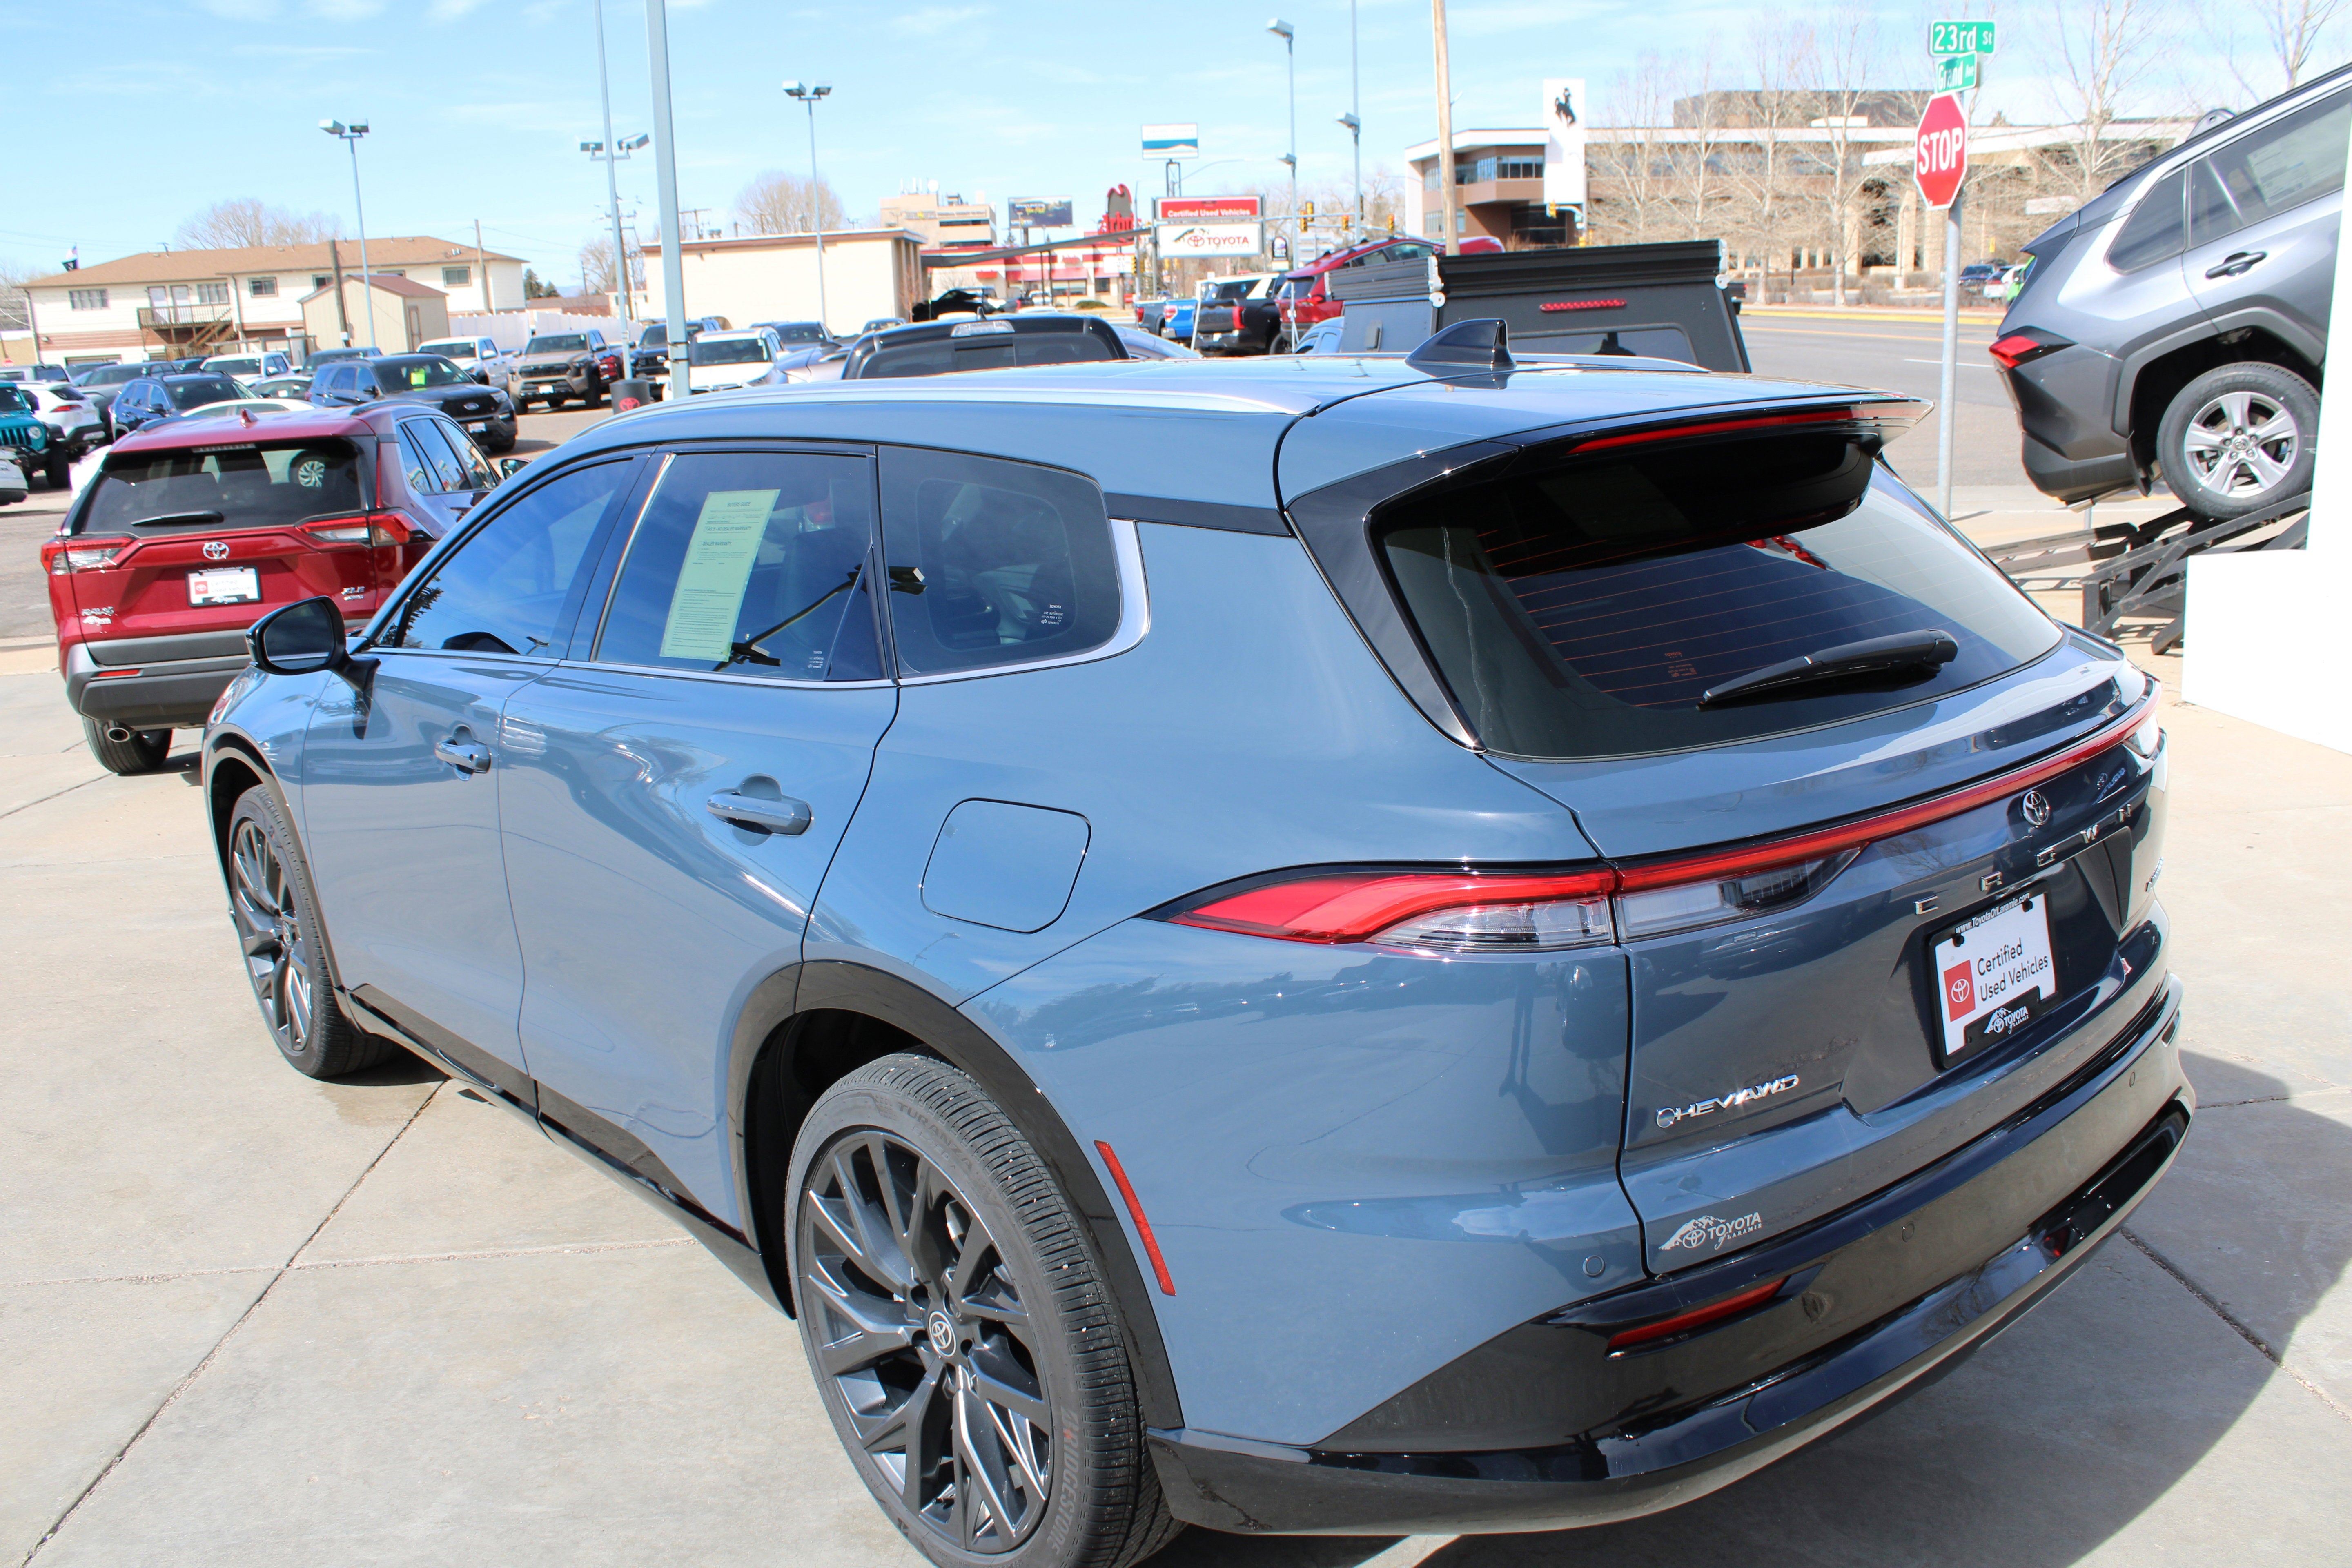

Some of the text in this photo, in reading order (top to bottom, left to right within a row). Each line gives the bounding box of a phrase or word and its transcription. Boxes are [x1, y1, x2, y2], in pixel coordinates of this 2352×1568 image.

[1934, 24, 1993, 51] 23rd St
[1938, 60, 1974, 90] Grand Ave
[1919, 127, 1964, 175] STOP
[1167, 209, 1198, 218] Certified
[1220, 208, 1250, 216] Vehicles
[1206, 236, 1250, 245] TOYOTA
[1915, 803, 2132, 915] CROWN
[1955, 892, 2030, 933] www.ToyotaOfLaramie.com
[1977, 937, 2023, 976] Certified
[1980, 956, 2048, 1002] Used Vehicles
[2003, 1006, 2029, 1027] TOYOTA
[2013, 1015, 2029, 1027] LARAMIE
[898, 1102, 973, 1170] TURANZA
[1707, 1212, 1761, 1240] TOYOTA
[1727, 1223, 1762, 1240] LARAMIE
[1046, 1405, 1079, 1555] BRIDGESTONE
